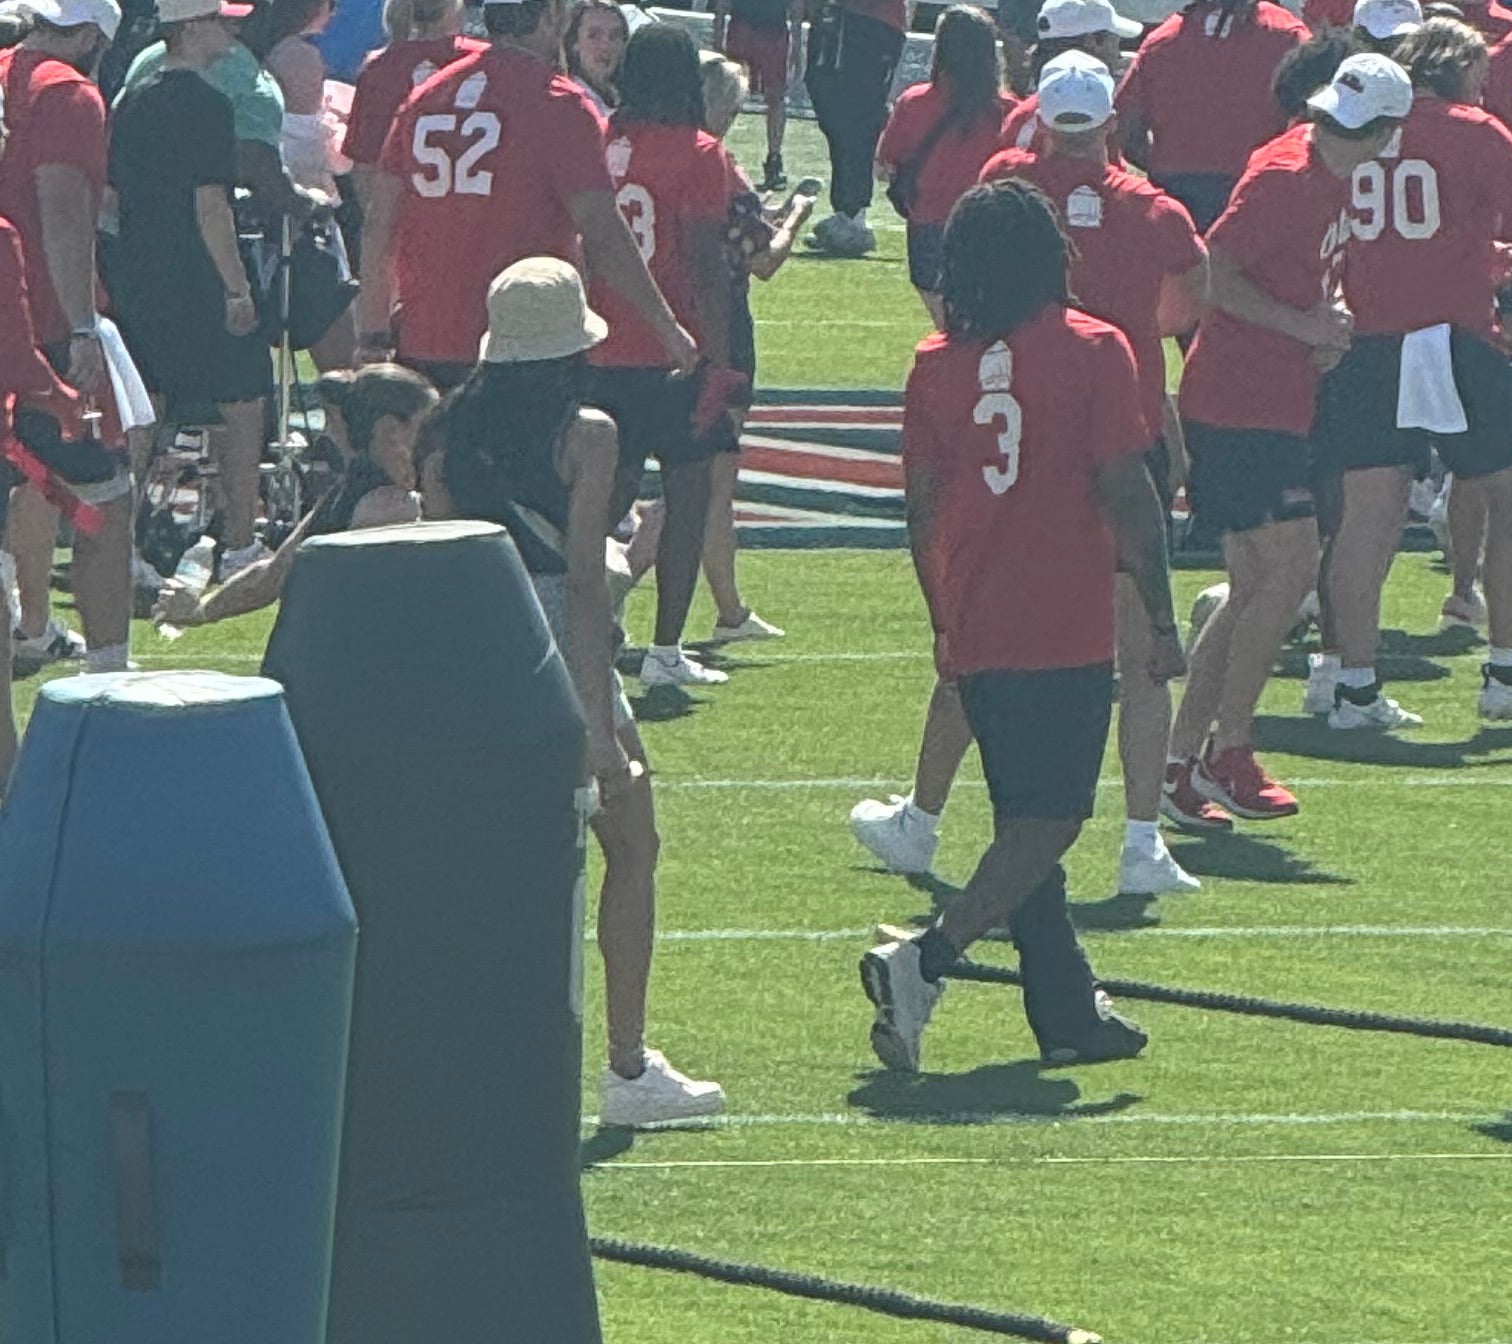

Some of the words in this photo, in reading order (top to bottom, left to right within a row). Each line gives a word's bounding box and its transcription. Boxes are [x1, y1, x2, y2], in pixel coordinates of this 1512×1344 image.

[411, 111, 501, 197] 52
[1350, 159, 1441, 241] 90
[973, 392, 1022, 495] 3
